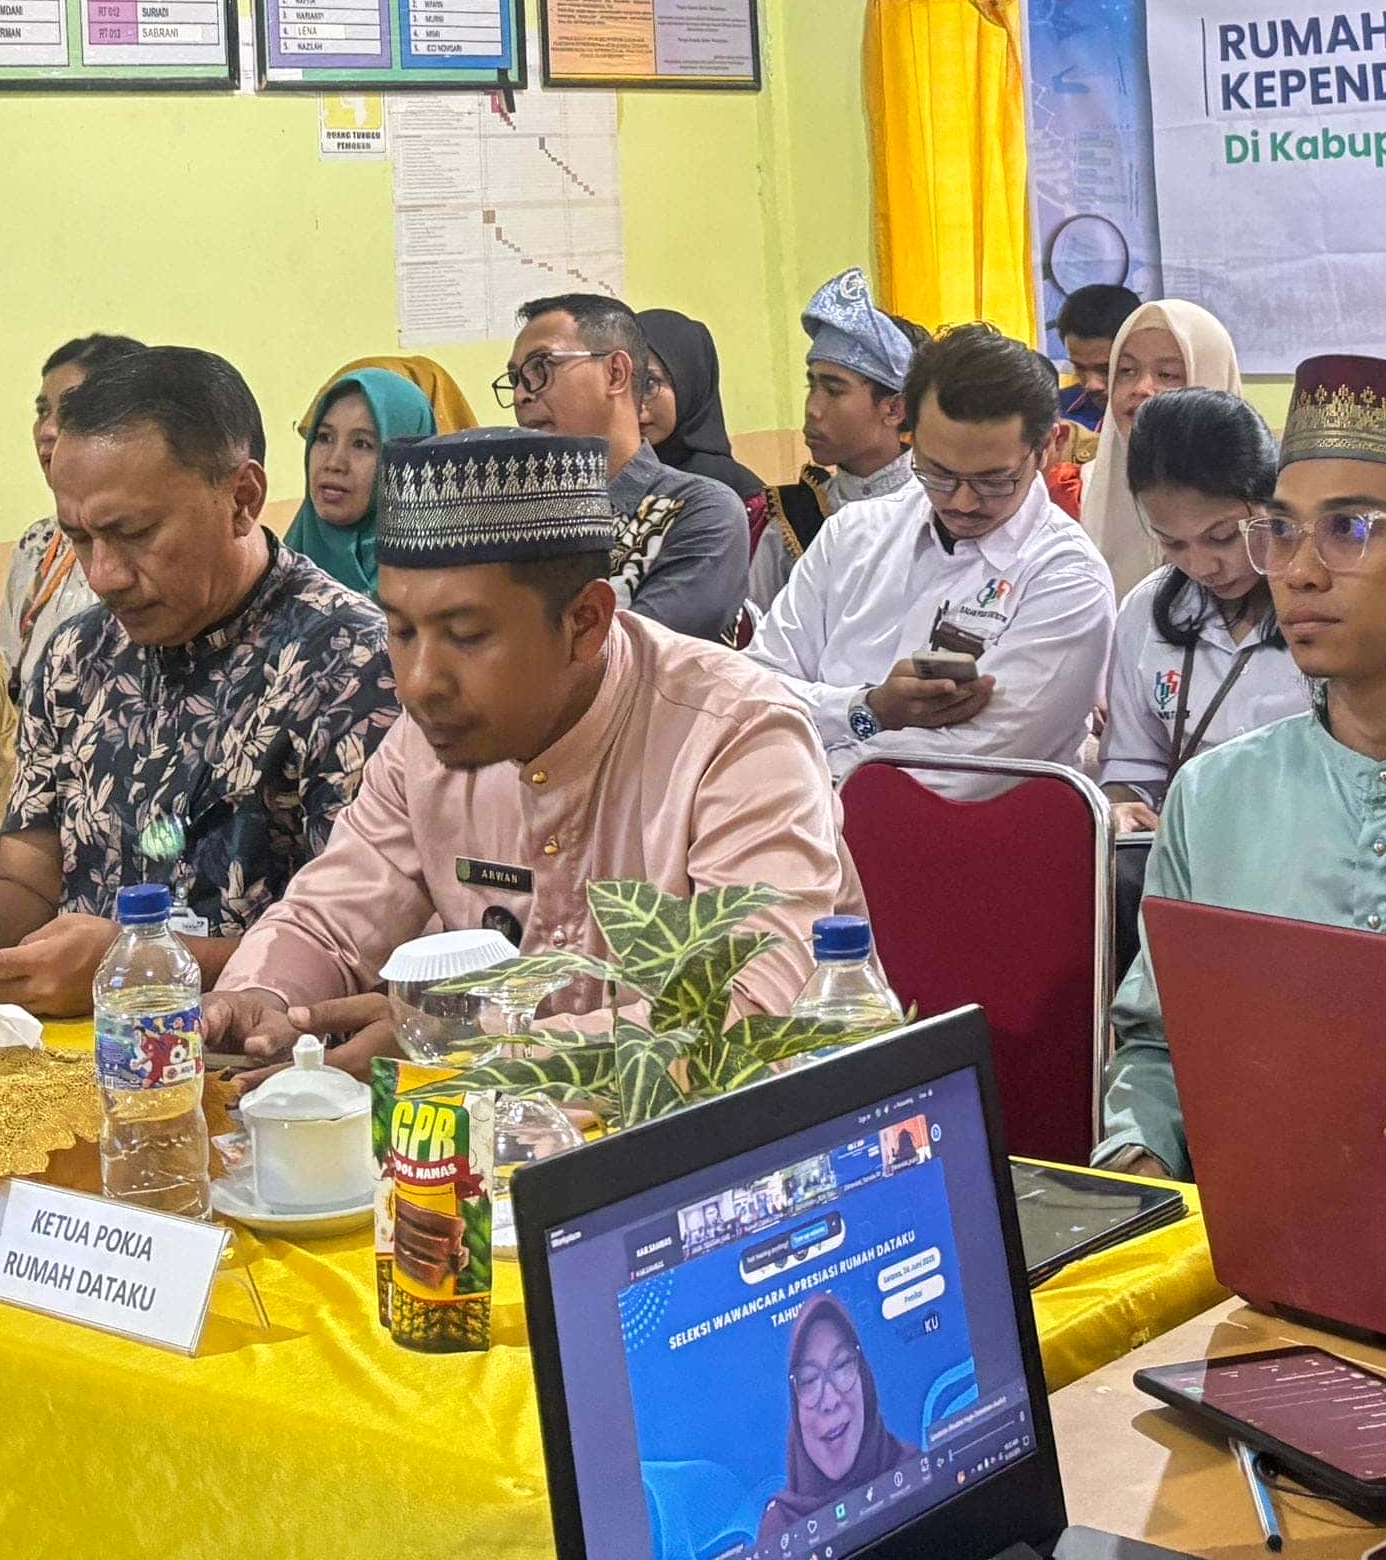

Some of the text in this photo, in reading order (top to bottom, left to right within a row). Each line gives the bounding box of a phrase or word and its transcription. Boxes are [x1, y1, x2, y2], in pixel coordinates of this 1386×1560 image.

[142, 28, 179, 38] SABRANI
[1224, 129, 1261, 164] Di
[481, 869, 518, 884] ARWAN
[391, 1101, 457, 1162] GPR
[416, 1162, 457, 1180] NANAS
[31, 1209, 153, 1262] KETUA POKJA
[3, 1250, 157, 1312] RUMAH DATAKU
[668, 1320, 711, 1350] SELEKSI
[712, 1288, 786, 1331] WAWANCARA
[787, 1265, 839, 1297] APRESIASI
[839, 1247, 875, 1273] RUMAH
[877, 1230, 915, 1256] DATAKU
[770, 1301, 805, 1328] TAHU
[924, 1315, 939, 1333] KU
